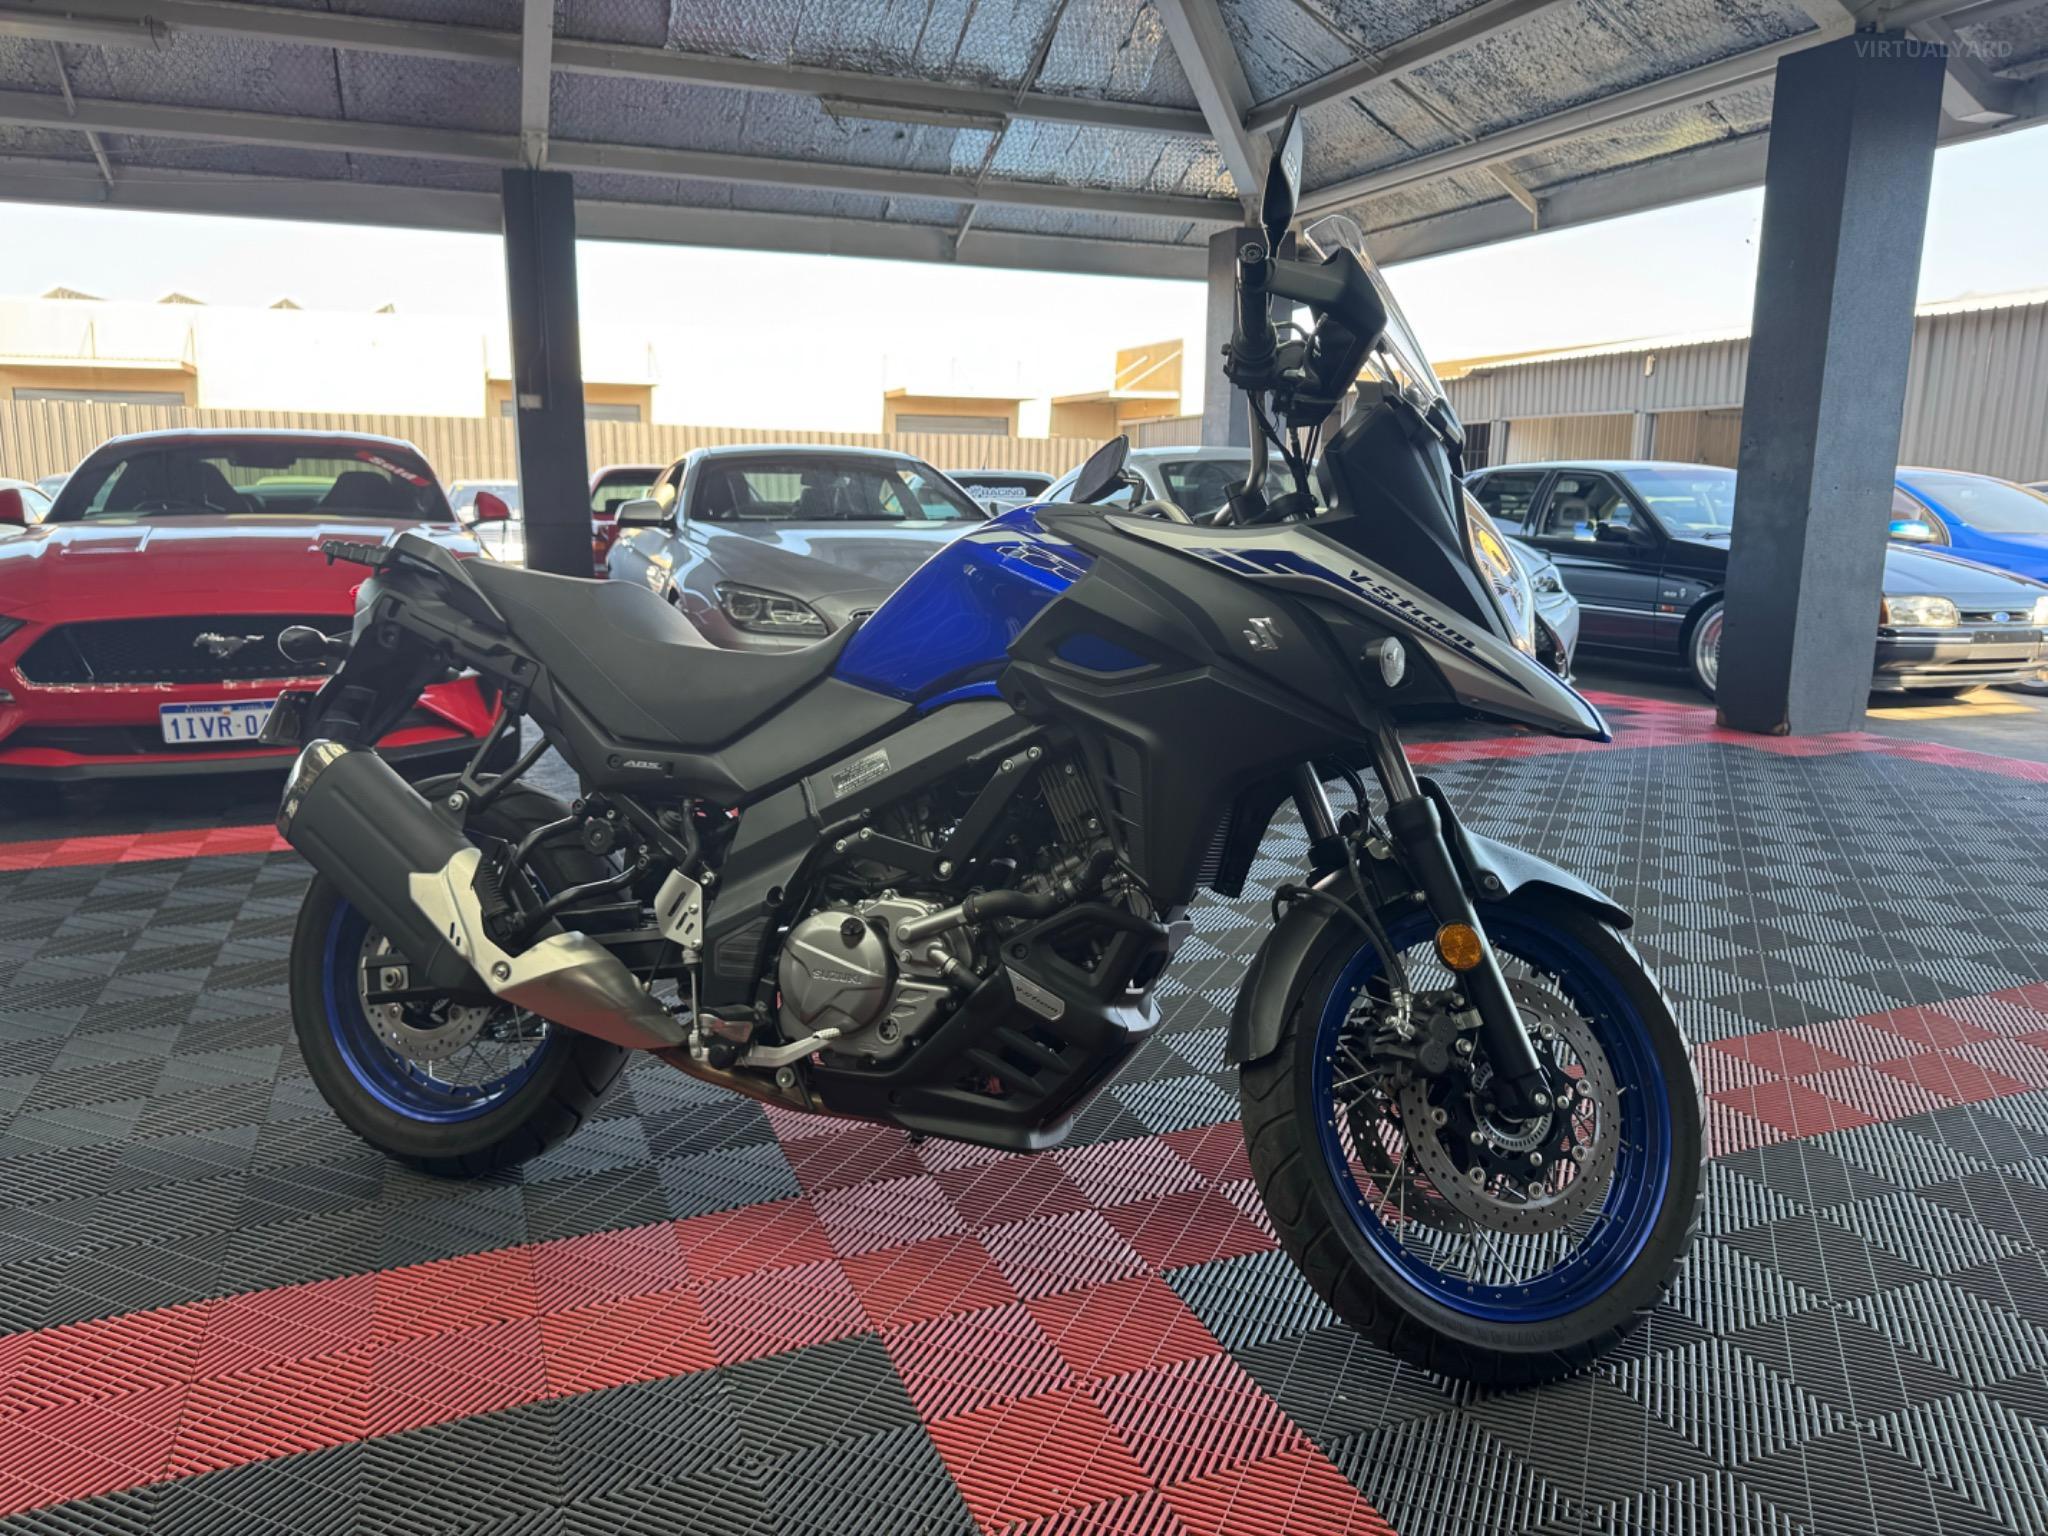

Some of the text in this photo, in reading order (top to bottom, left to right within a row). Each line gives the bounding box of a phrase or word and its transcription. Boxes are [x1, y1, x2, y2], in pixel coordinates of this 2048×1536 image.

[367, 455, 419, 481] Sold
[981, 487, 1025, 497] RACING
[1349, 569, 1475, 649] V-Strom
[623, 760, 663, 770] ABS
